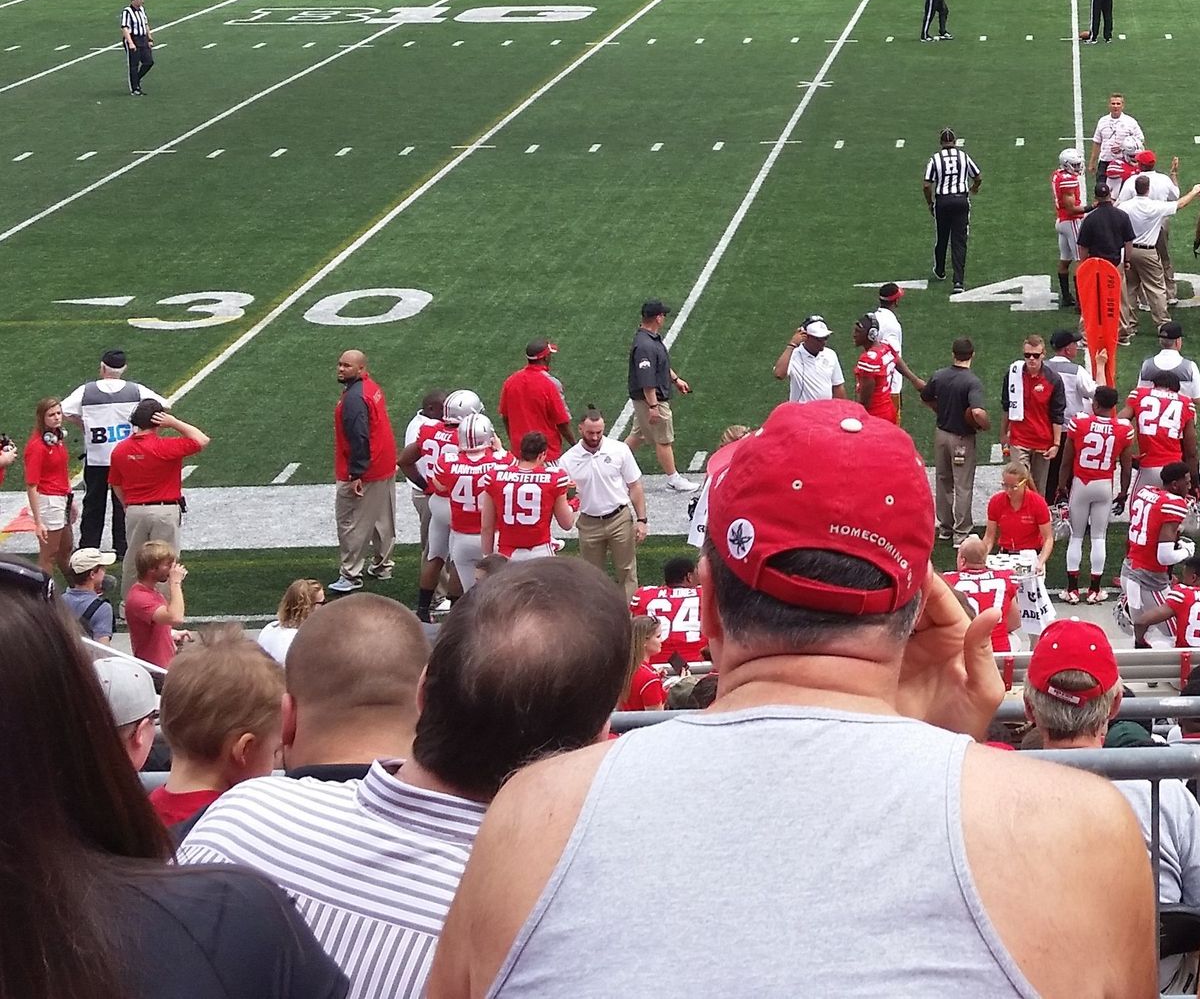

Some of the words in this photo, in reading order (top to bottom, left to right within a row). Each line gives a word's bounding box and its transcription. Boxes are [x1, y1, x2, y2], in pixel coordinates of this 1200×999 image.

[944, 156, 958, 174] H
[1139, 395, 1184, 439] 24
[1079, 432, 1116, 470] 21
[496, 470, 551, 483] RAMSTETTER
[502, 483, 542, 525] 19
[1128, 498, 1153, 546] 21
[829, 524, 909, 569] HOMECOMING
[646, 597, 702, 643] 64
